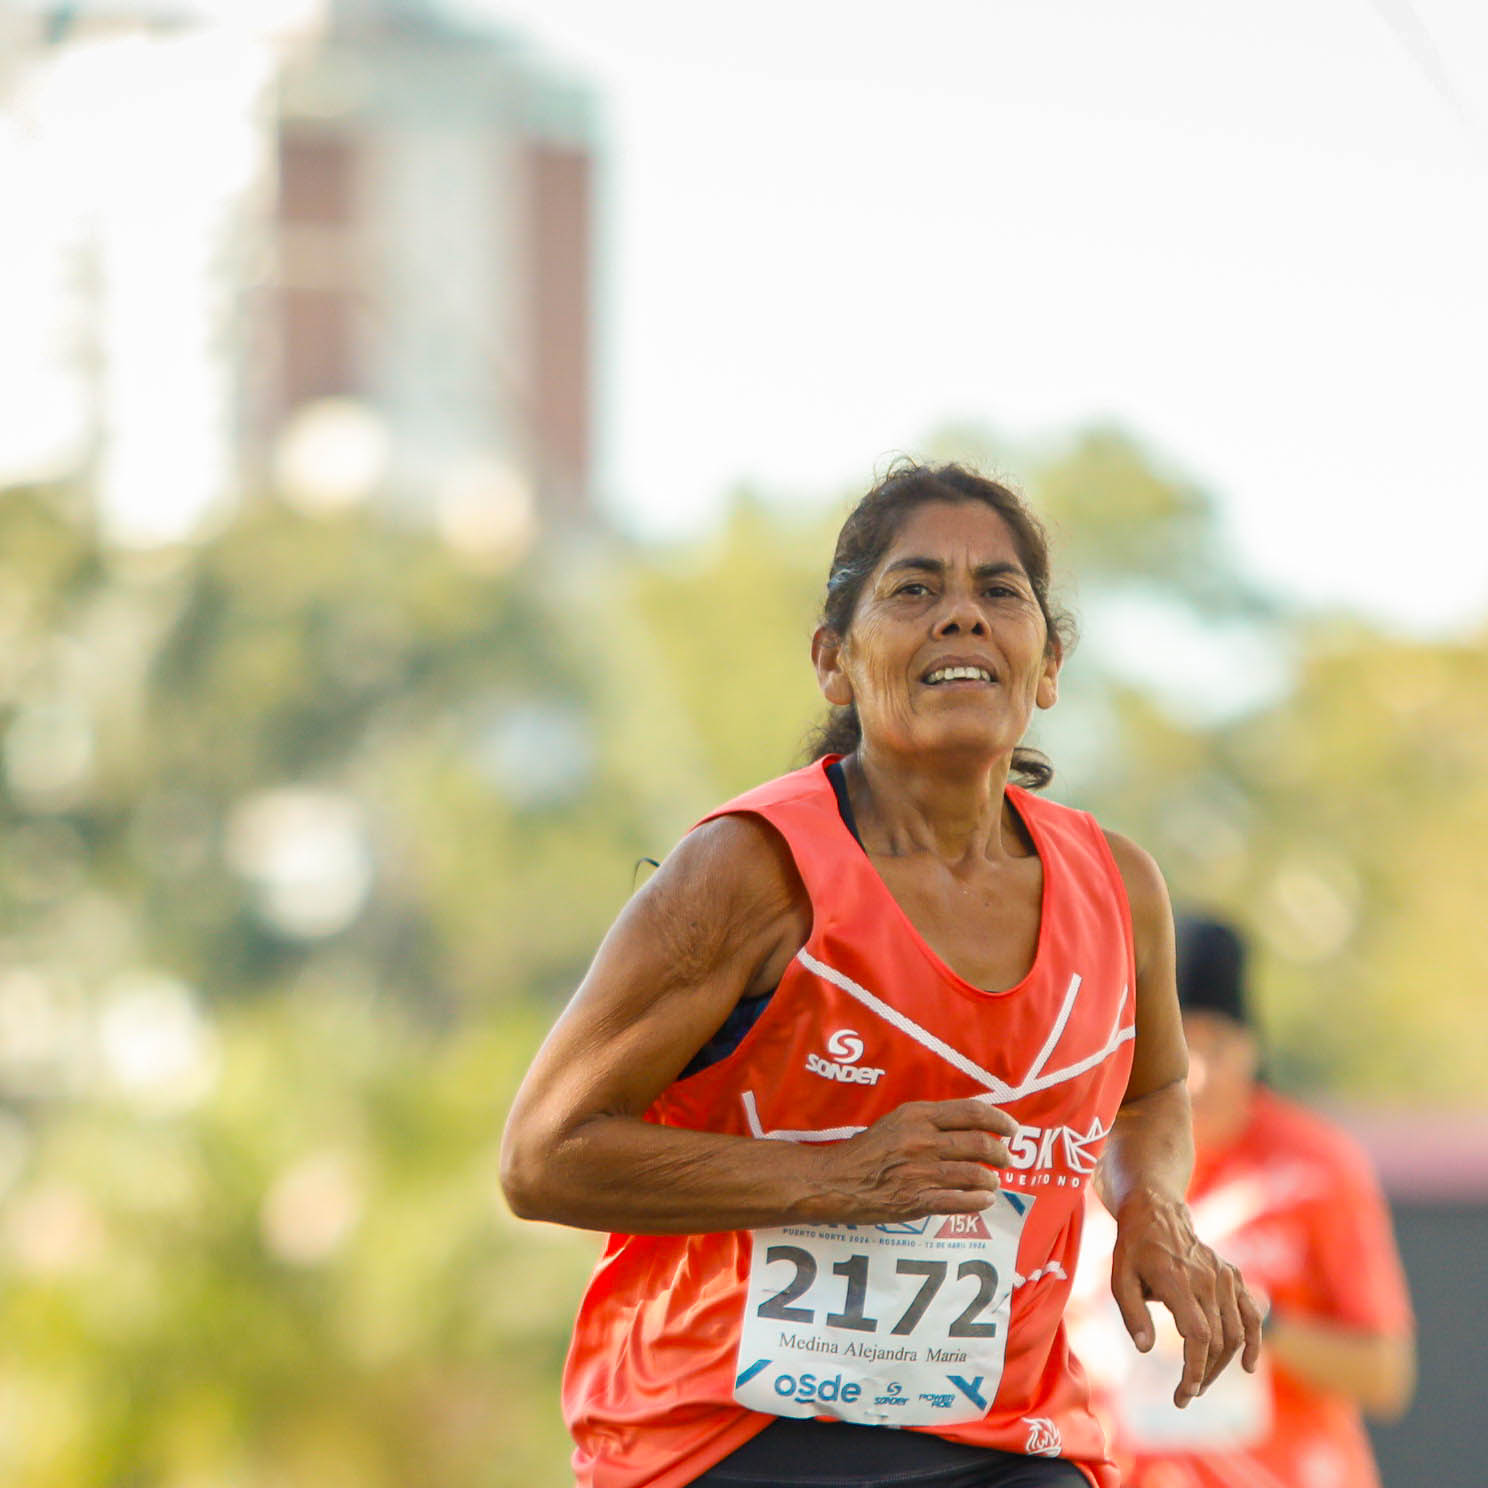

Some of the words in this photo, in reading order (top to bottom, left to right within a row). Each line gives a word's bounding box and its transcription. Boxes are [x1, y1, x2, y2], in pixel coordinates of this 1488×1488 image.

[949, 1214, 980, 1233] 15K
[818, 1232, 846, 1242] NORTE
[879, 1237, 916, 1248] ROSARIO
[757, 1245, 999, 1339] 2172
[779, 1332, 838, 1354] Medina
[844, 1341, 917, 1362] Alejandra
[774, 1374, 862, 1404] osde
